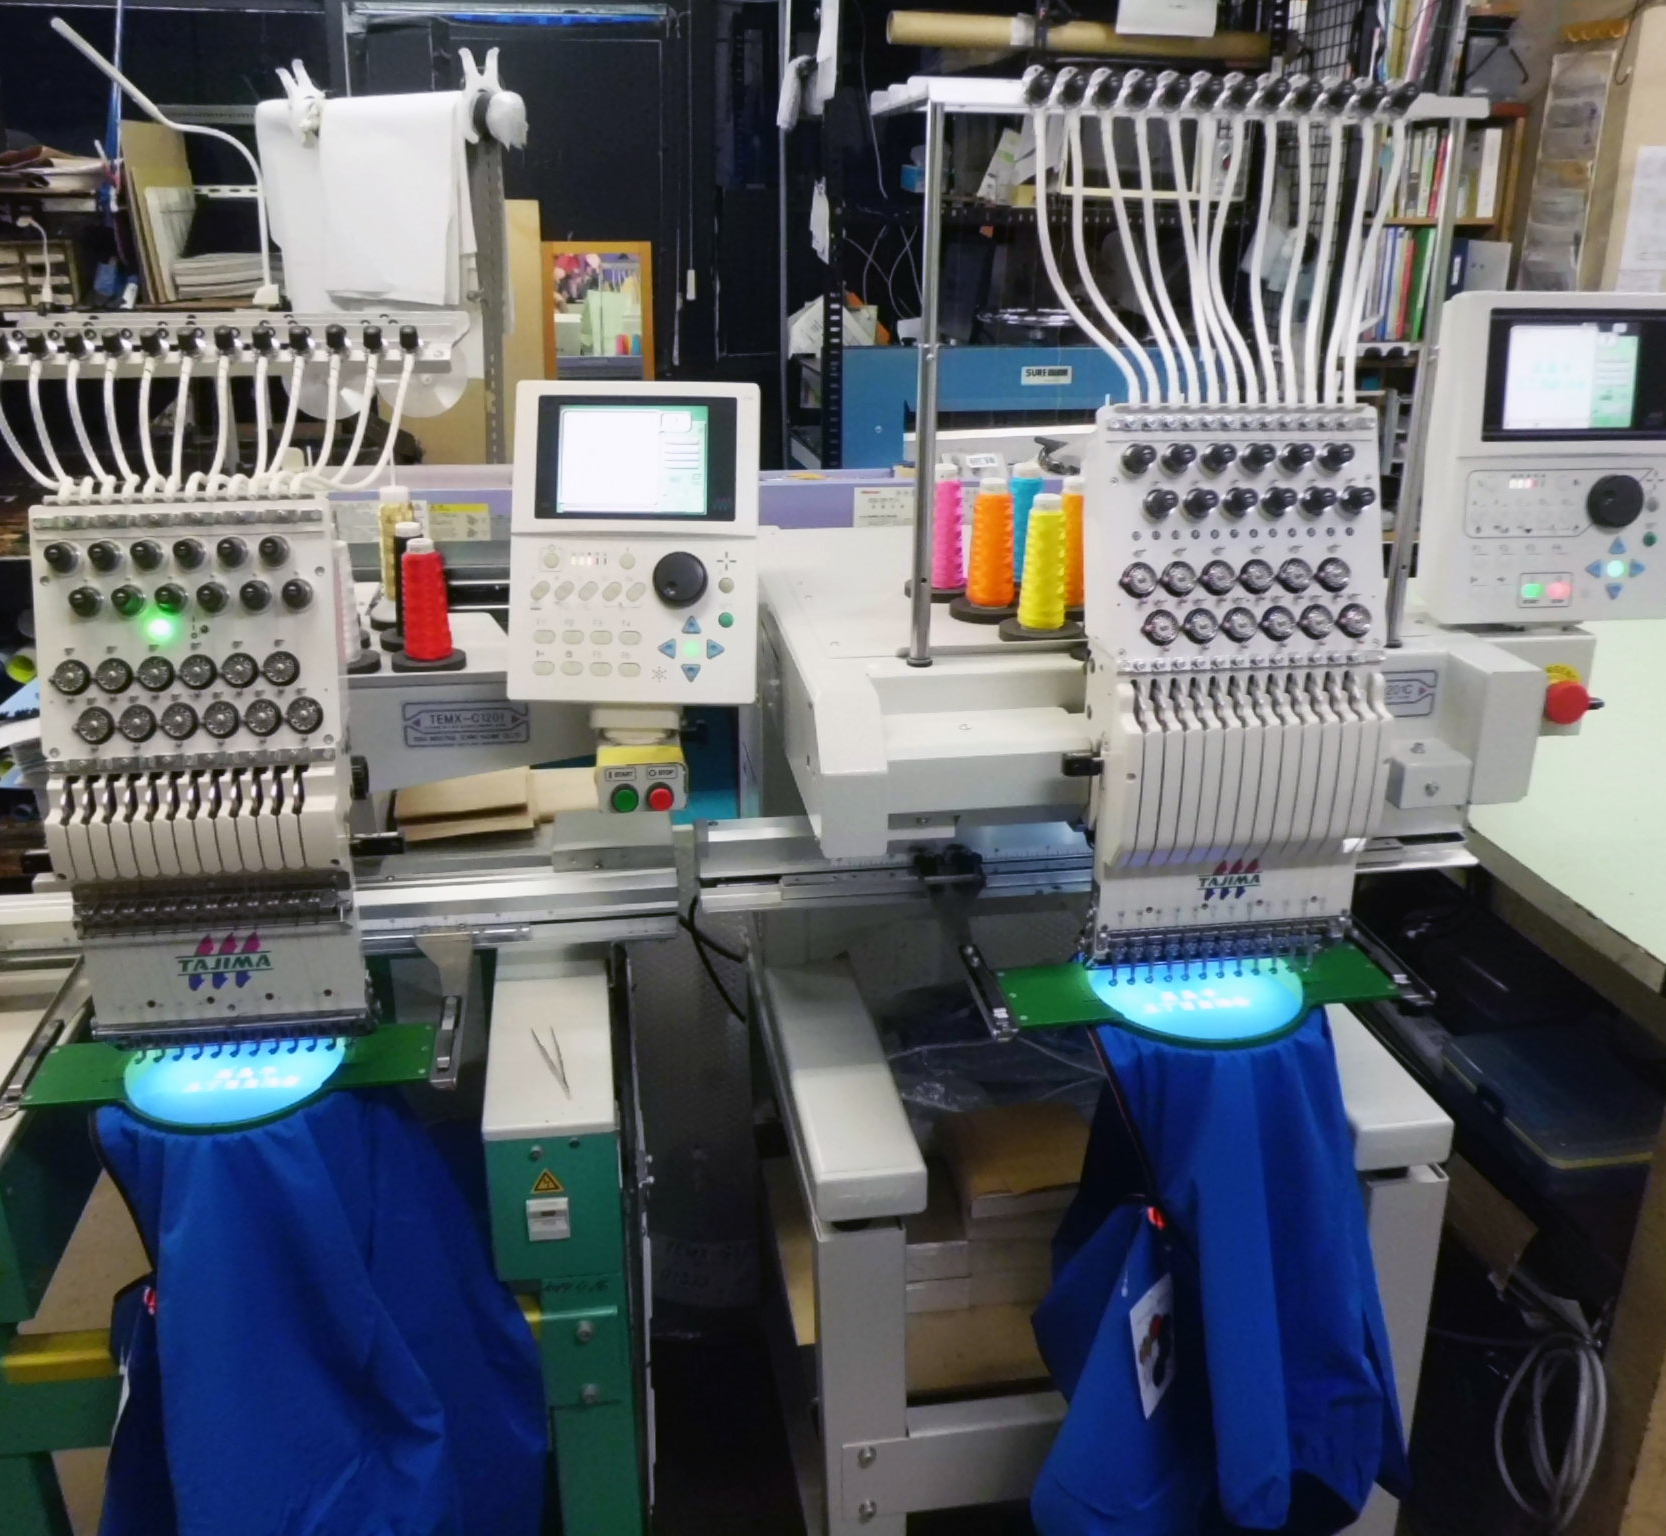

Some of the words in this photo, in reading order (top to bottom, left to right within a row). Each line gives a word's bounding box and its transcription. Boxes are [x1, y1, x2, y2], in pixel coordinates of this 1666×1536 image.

[429, 712, 506, 725] TEMX-C1201
[1198, 874, 1260, 887] TAJIMA
[177, 953, 271, 972] TAJIMA
